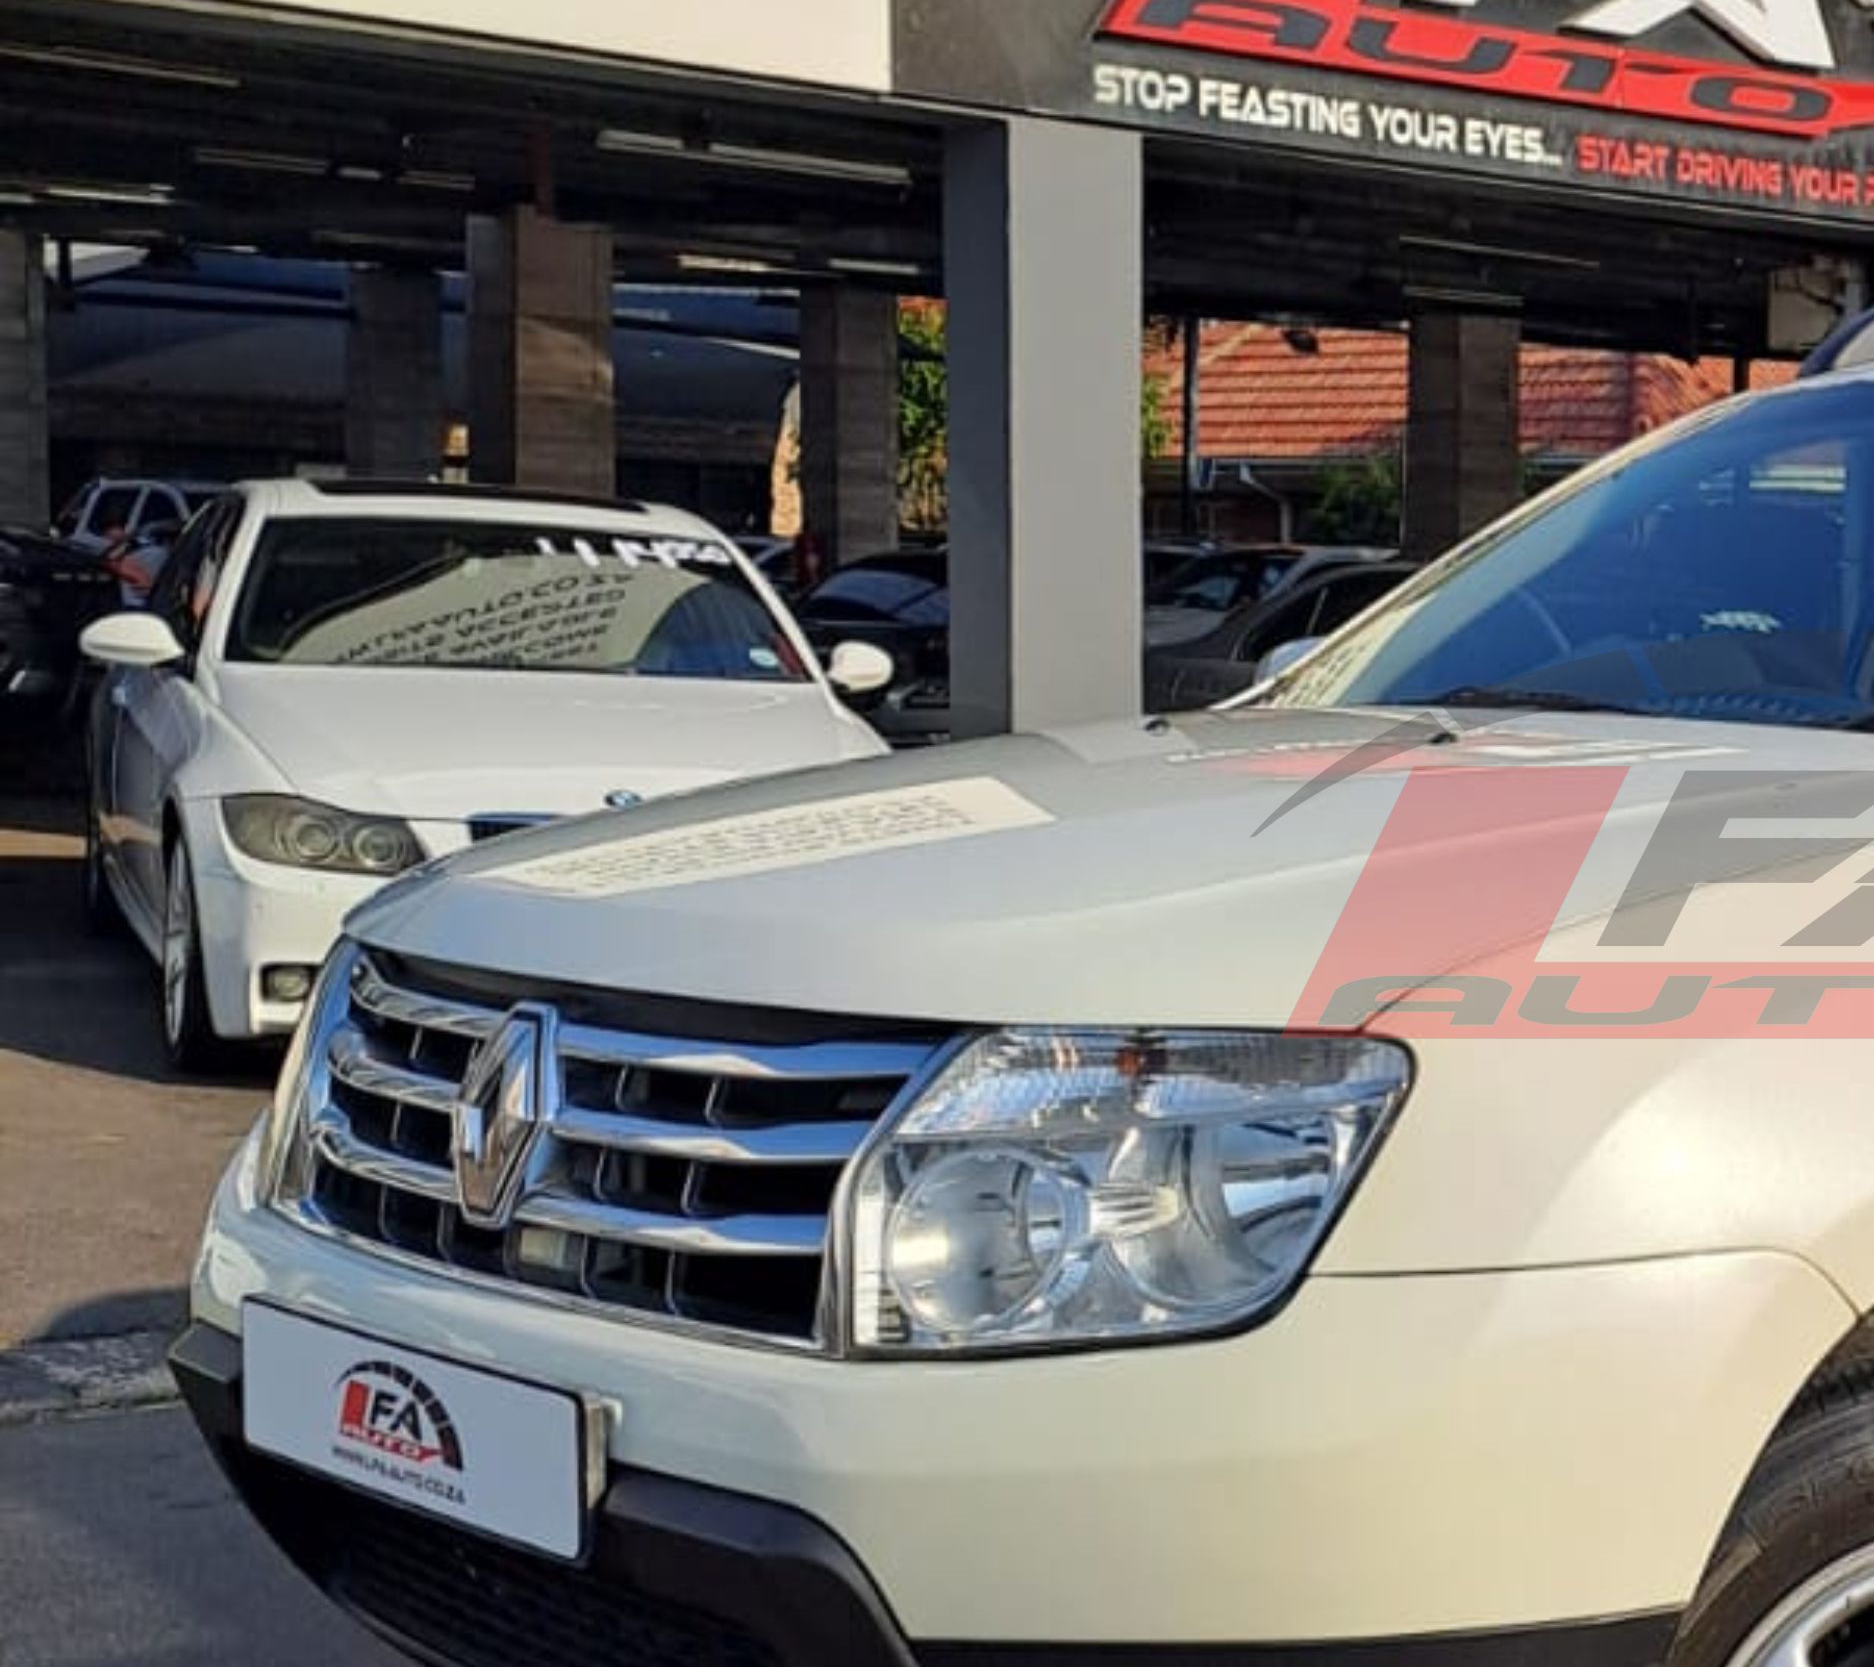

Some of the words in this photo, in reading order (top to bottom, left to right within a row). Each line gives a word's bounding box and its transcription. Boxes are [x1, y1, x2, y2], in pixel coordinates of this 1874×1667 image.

[1092, 63, 1191, 114] STOP
[1198, 79, 1362, 138] FEASTING
[1367, 103, 1458, 153] YOUR
[1576, 135, 1669, 179] START
[1675, 149, 1783, 198] DRIVING
[1788, 162, 1860, 203] YOUR
